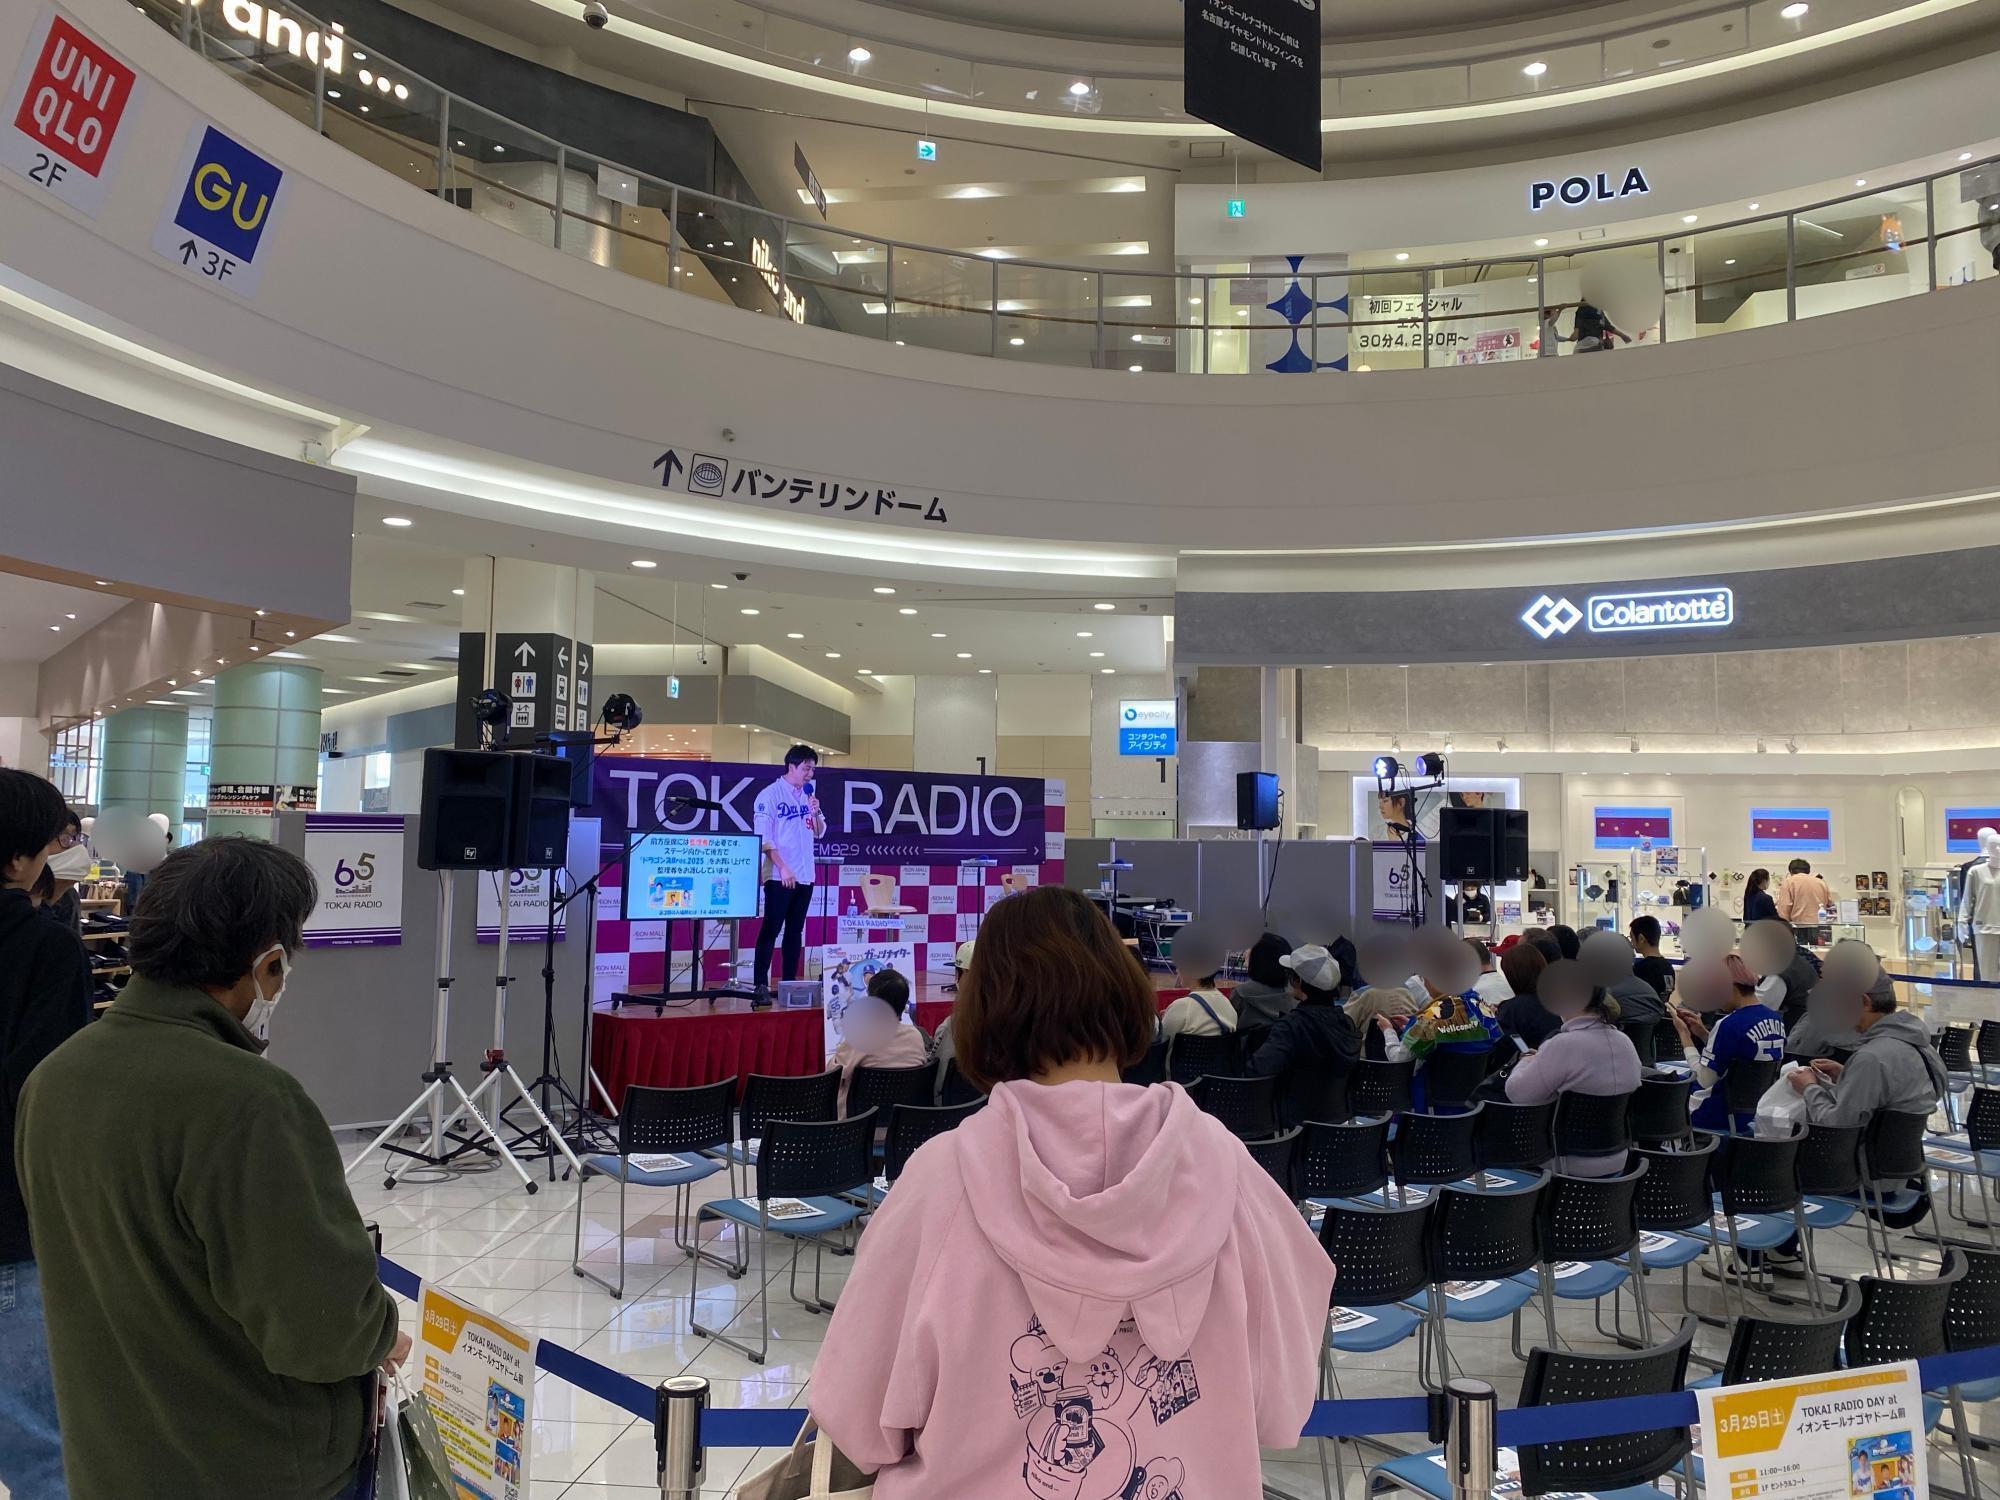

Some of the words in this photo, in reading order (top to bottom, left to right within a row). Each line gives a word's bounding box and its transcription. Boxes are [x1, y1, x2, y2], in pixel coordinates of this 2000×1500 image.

[50, 37, 116, 111] UNI
[32, 86, 101, 155] QLO
[28, 152, 67, 188] 2F
[193, 162, 269, 231] GU
[1532, 167, 1649, 210] POLA
[201, 252, 237, 281] 3F
[731, 468, 948, 523] バンテリンドーム
[1128, 741, 1166, 750] アイシティ
[1156, 758, 1166, 783] 1
[610, 770, 757, 834] TOK
[844, 781, 1023, 837] RADIO
[324, 902, 352, 910] TOKAI
[354, 901, 383, 909] RADIO
[523, 900, 549, 908] RADIO
[467, 1331, 486, 1347] TOKAI
[503, 1350, 514, 1363] DAY
[1796, 1407, 1906, 1435] イオンモールナゴヤドーム前
[1802, 1406, 1832, 1418] TOKAI
[1834, 1402, 1864, 1414] RADIO
[1867, 1397, 1886, 1408] DAY
[1888, 1395, 1898, 1404] at
